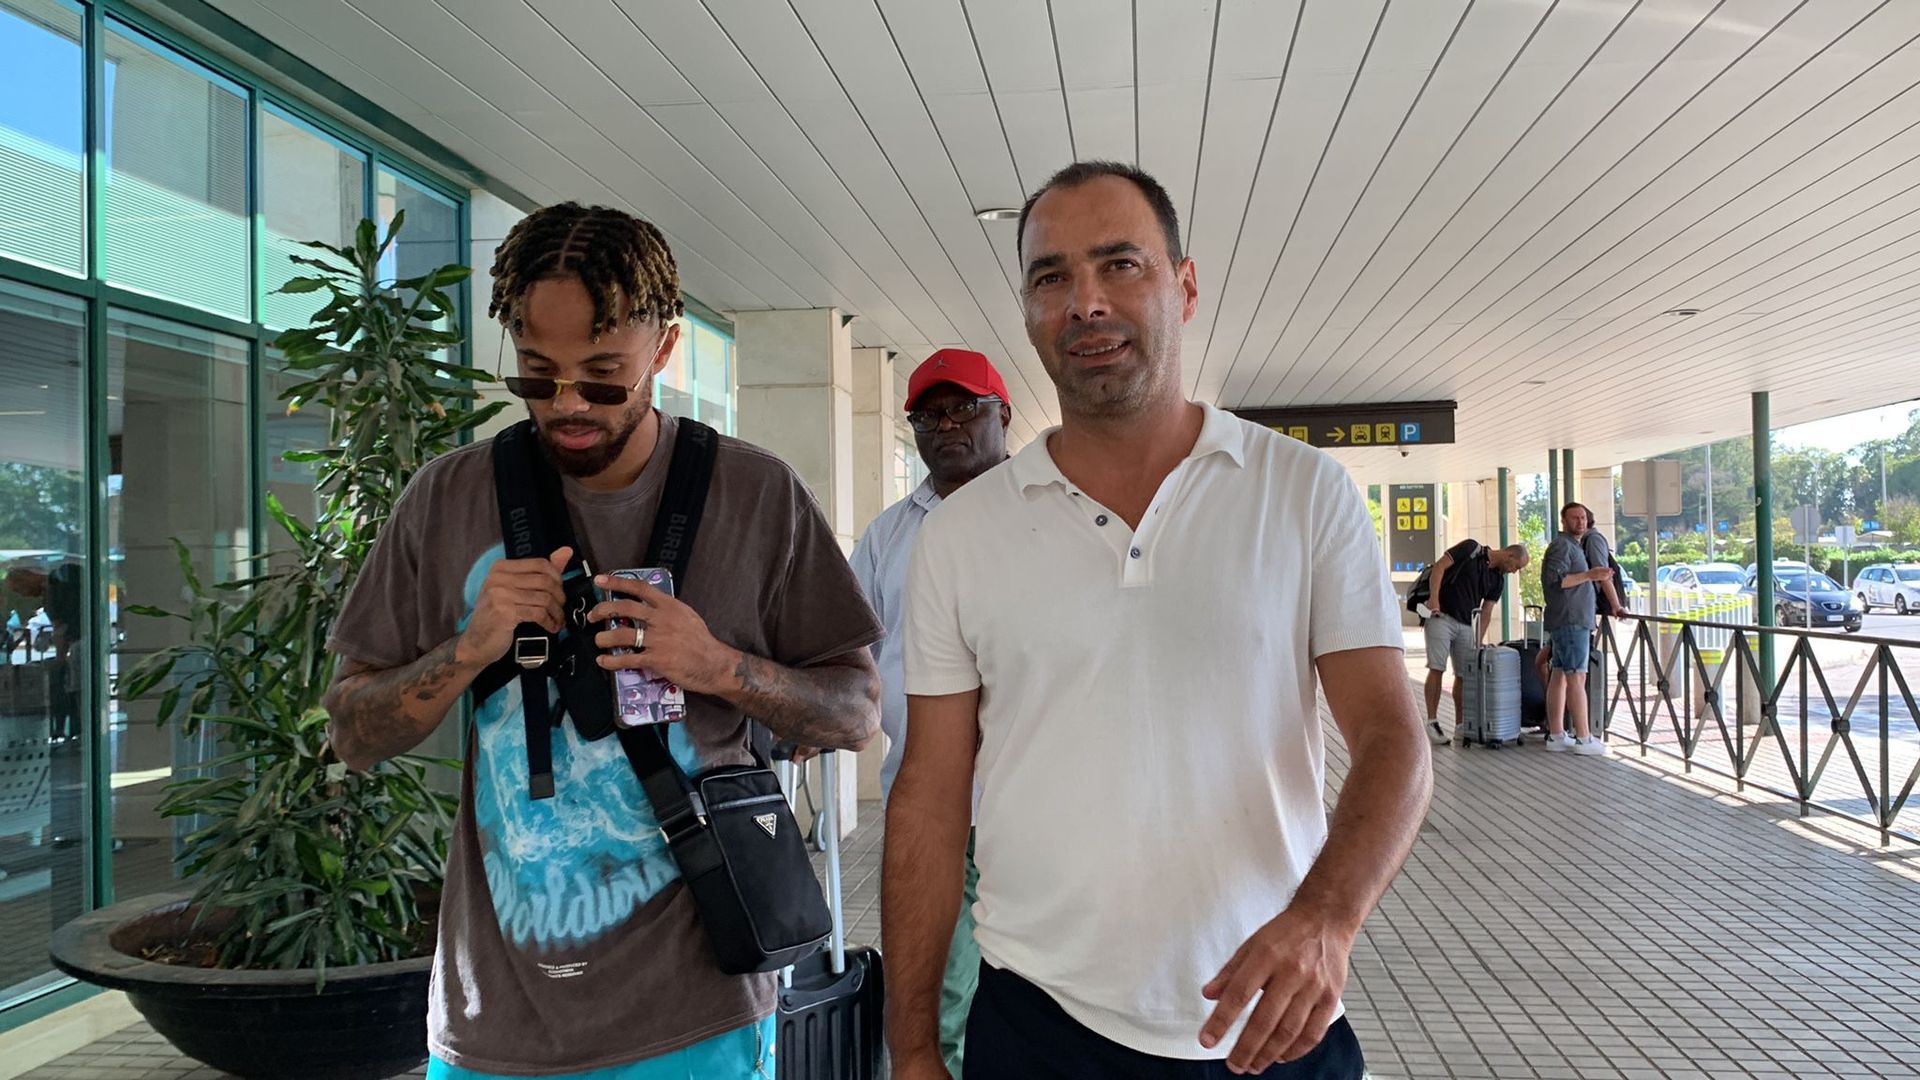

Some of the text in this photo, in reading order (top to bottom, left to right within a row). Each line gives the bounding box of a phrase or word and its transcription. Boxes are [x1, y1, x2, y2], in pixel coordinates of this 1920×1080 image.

[1404, 424, 1416, 440] P
[510, 506, 533, 557] BURB
[657, 512, 689, 567] BURB
